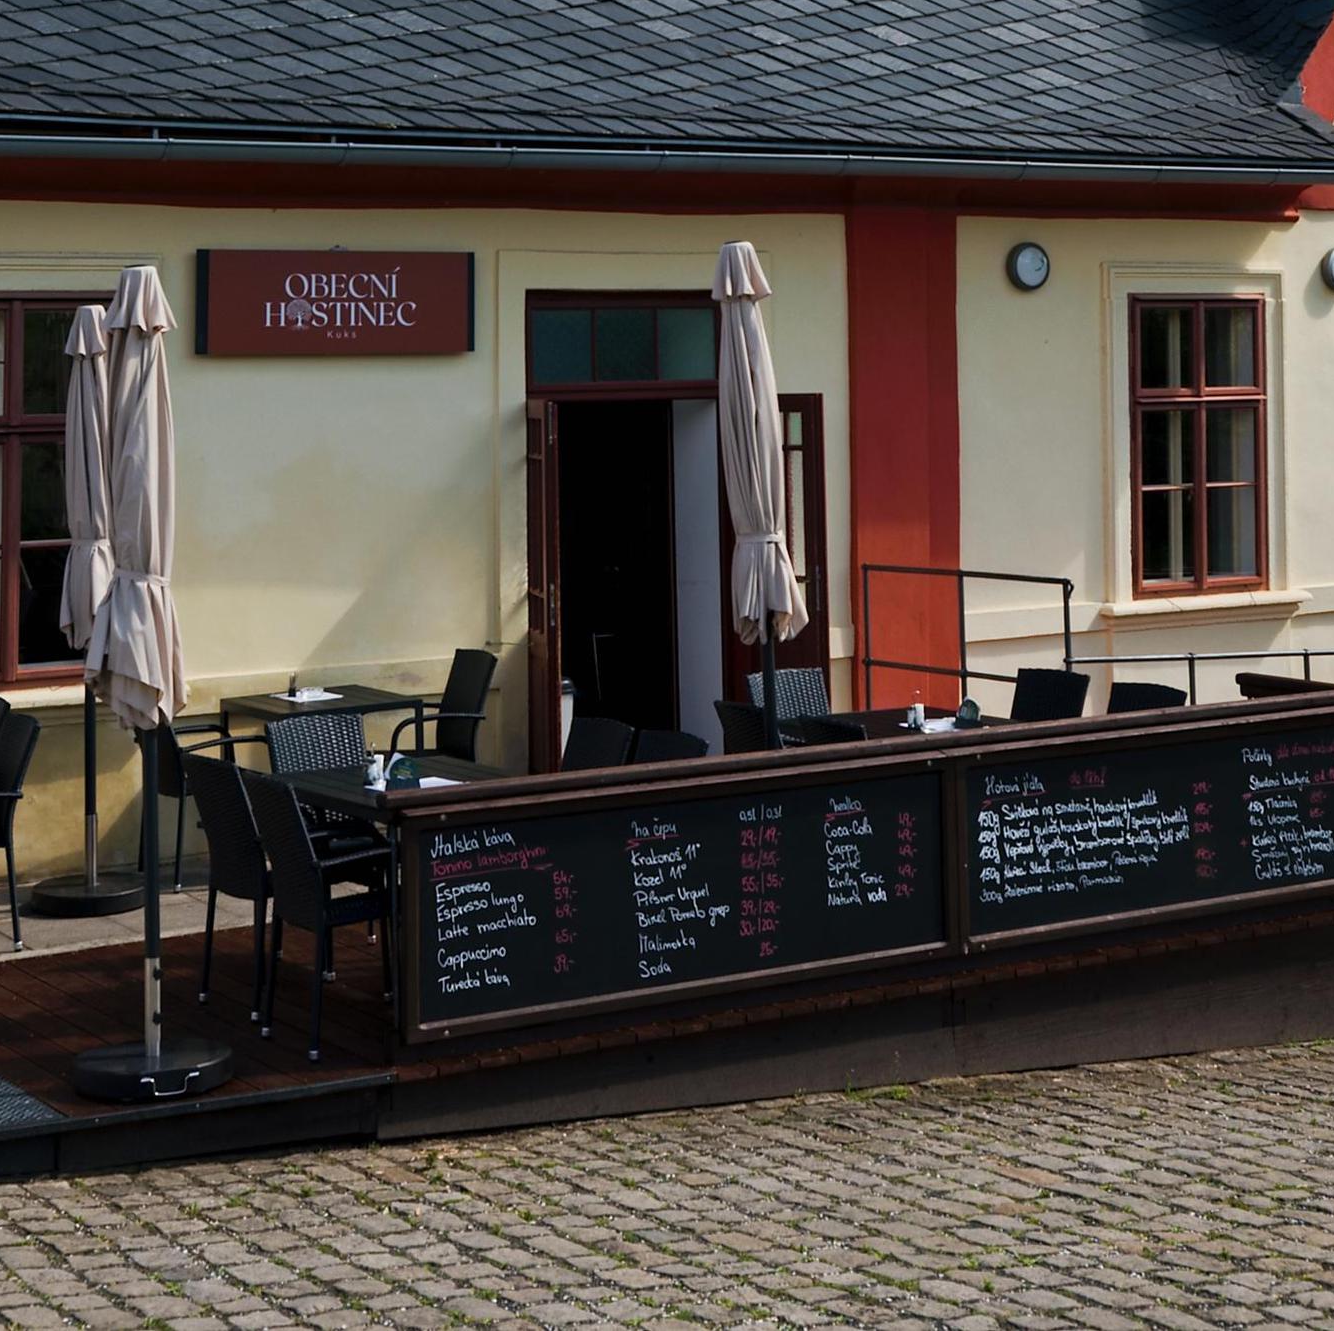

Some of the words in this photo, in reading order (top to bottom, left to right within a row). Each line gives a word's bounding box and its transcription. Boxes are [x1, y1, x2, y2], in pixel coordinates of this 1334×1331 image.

[284, 266, 401, 299] OBECNÍ
[264, 300, 417, 330] HOSTINEC
[326, 330, 358, 339] Kuks
[483, 827, 515, 846] káva
[631, 847, 683, 867] Krakonoš
[826, 840, 860, 862] Cappy
[634, 867, 664, 886] Kozel
[827, 857, 860, 874] Sprite
[435, 881, 492, 905] Espresso
[436, 899, 488, 923] Espresso
[490, 892, 525, 913] lungo
[437, 924, 469, 942] Latte
[477, 908, 537, 934] macchiato
[437, 944, 506, 970] Cappuccino
[638, 956, 673, 978] Soda
[484, 967, 510, 986] káva
